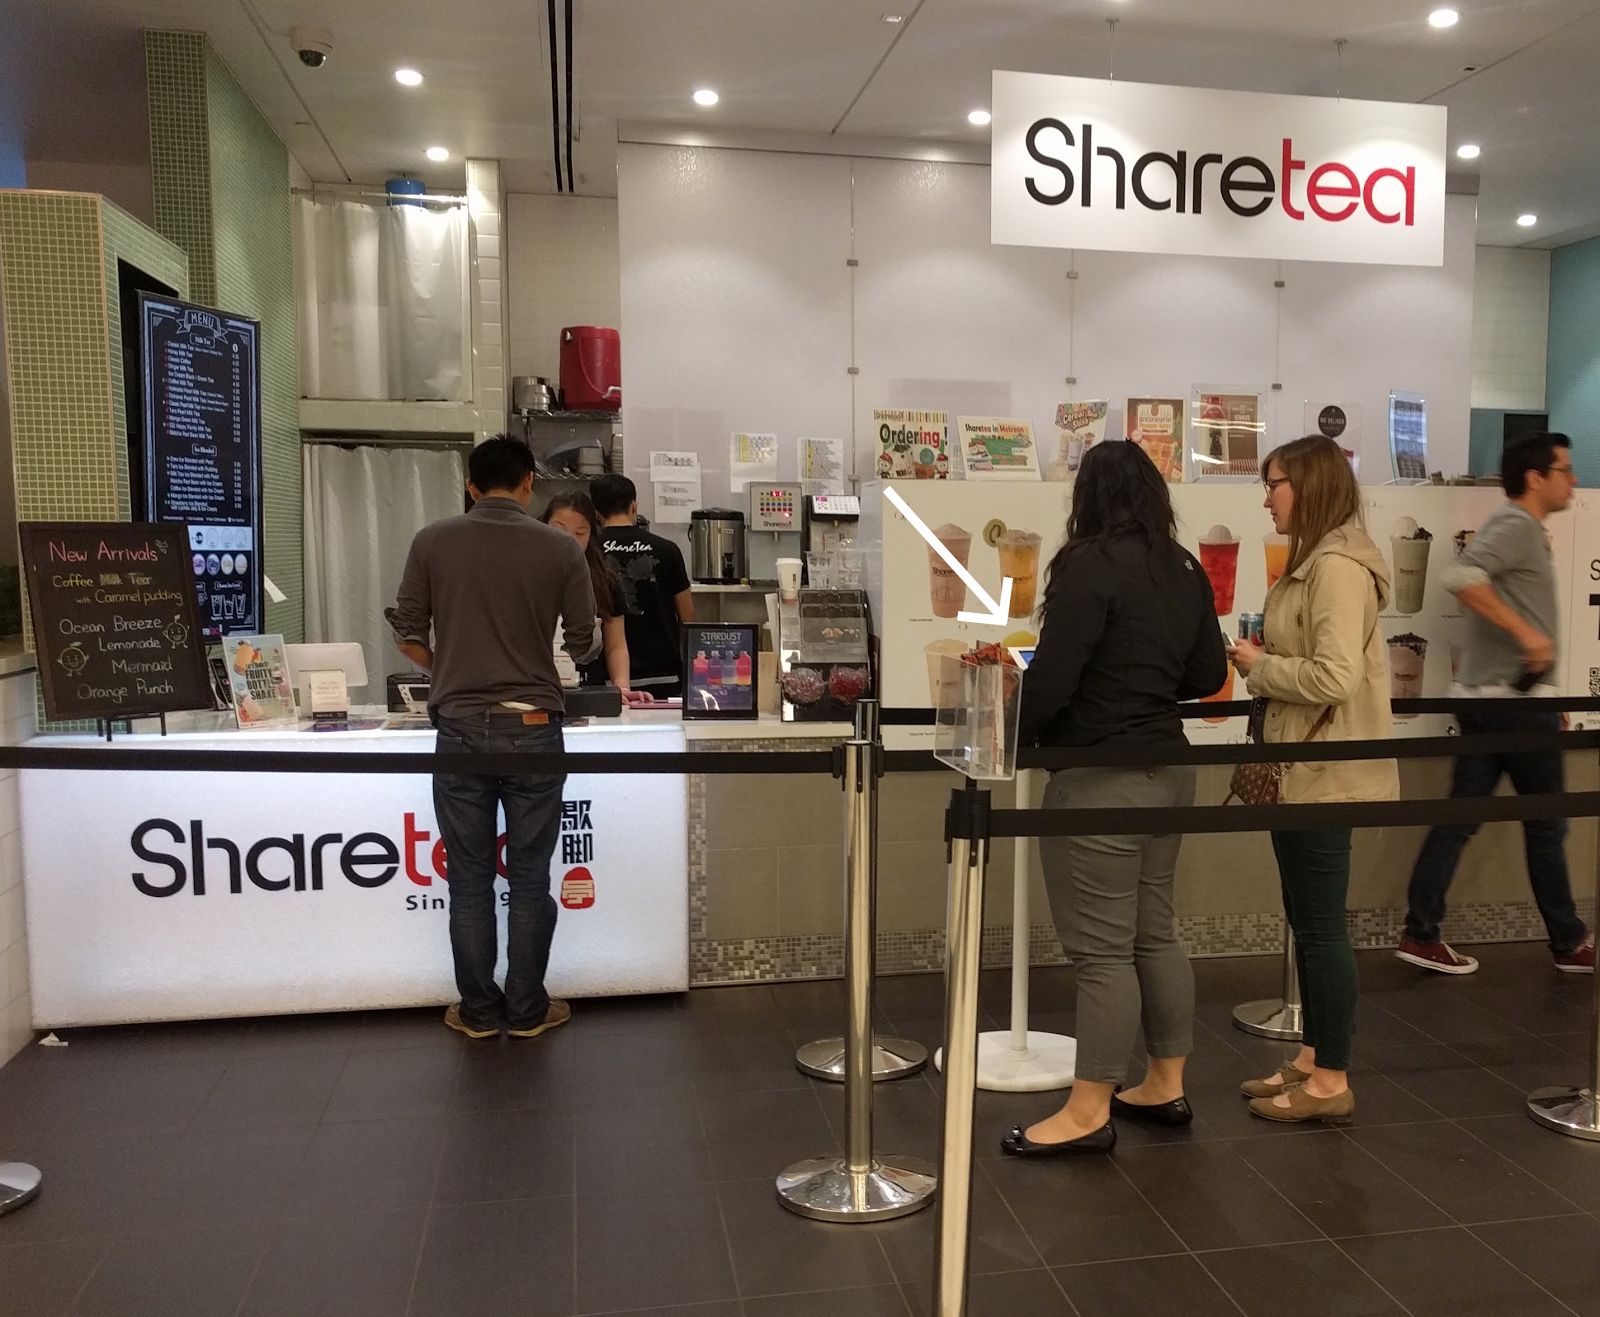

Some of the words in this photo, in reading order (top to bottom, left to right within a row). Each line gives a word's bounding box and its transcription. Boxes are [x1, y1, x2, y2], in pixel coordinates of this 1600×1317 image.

[1024, 117, 1415, 226] Sharetea
[191, 313, 214, 328] MENU
[880, 424, 940, 448] Ordering
[965, 424, 992, 432] Sharetea
[1000, 425, 1024, 433] Metreon
[50, 541, 88, 562] New
[98, 542, 158, 562] Arrivals
[603, 540, 653, 553] ShareTea
[52, 574, 94, 588] Coffee
[129, 572, 152, 584] Tea
[95, 588, 141, 604] Caramel
[144, 589, 183, 606] pudding
[59, 619, 105, 635] Ocean
[114, 616, 162, 631] Breeze
[98, 637, 161, 651] Lemonade
[700, 632, 742, 641] STARDUST
[112, 659, 173, 674] Mermaid
[245, 669, 272, 680] FRUITY
[77, 684, 128, 702] Orange
[136, 678, 174, 696] Punch
[250, 689, 276, 700] SHAKE
[131, 812, 508, 898] Sharet
[406, 894, 444, 910] Sin
